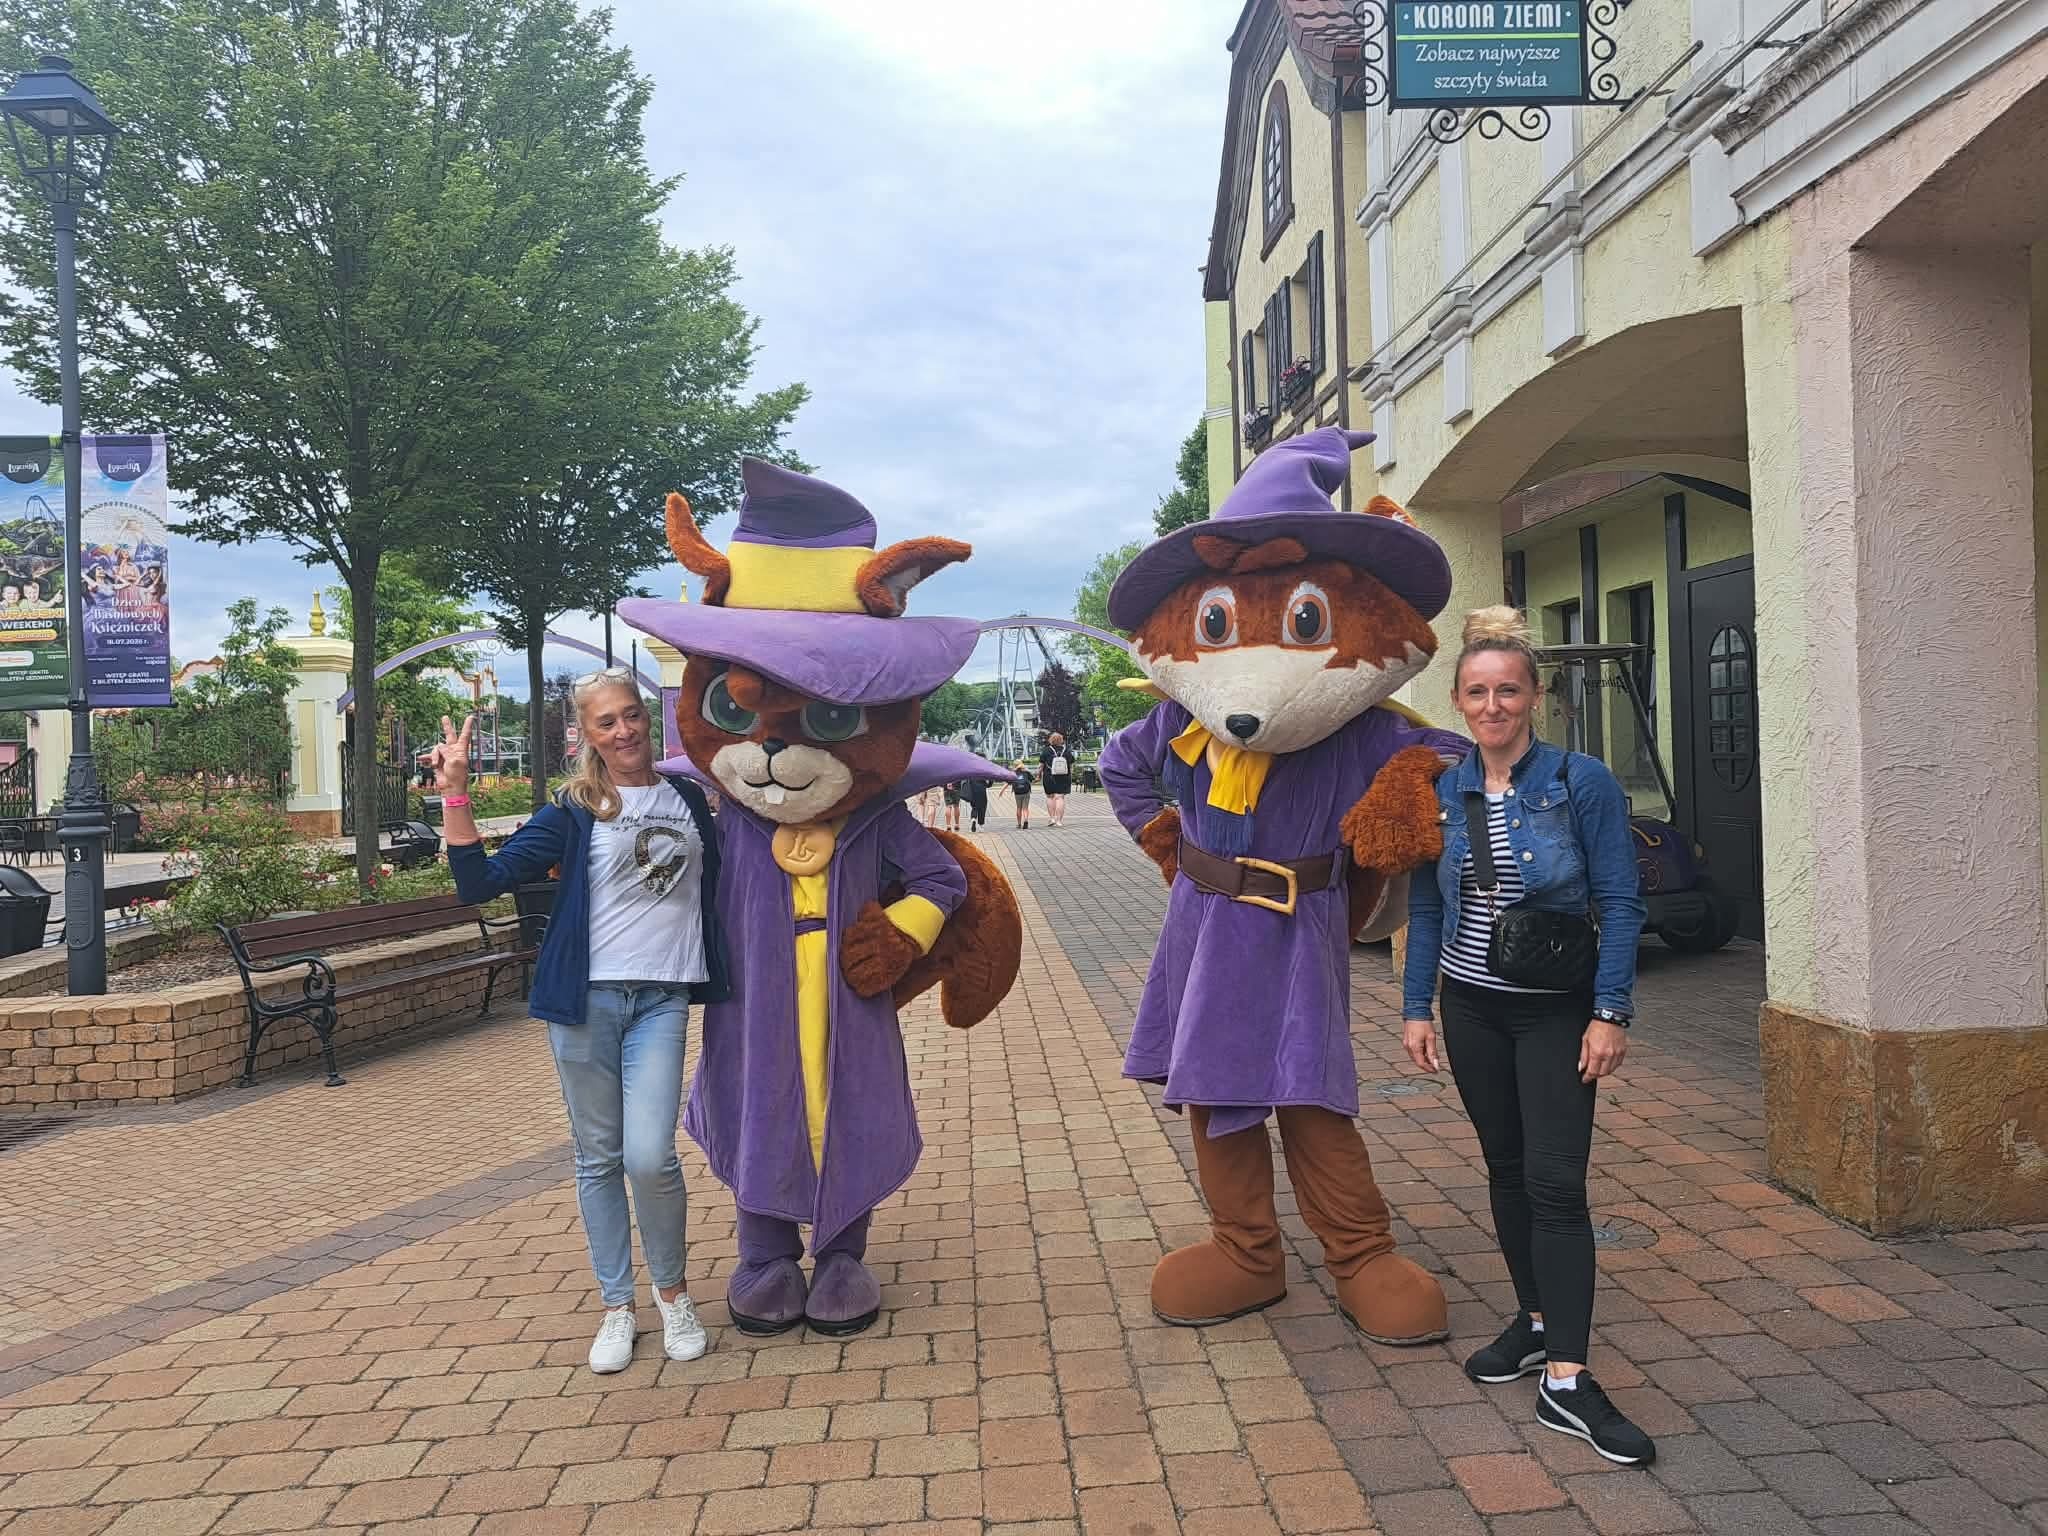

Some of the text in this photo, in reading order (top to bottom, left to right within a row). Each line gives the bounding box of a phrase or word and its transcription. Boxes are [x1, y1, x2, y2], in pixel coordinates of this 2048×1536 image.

[1414, 4, 1561, 29] KORONA ZIEMI
[1415, 41, 1560, 66] Zobacz najwyższe
[1433, 70, 1548, 94] szczyty świata
[2, 621, 53, 629] WEEKEND
[73, 847, 81, 862] 3
